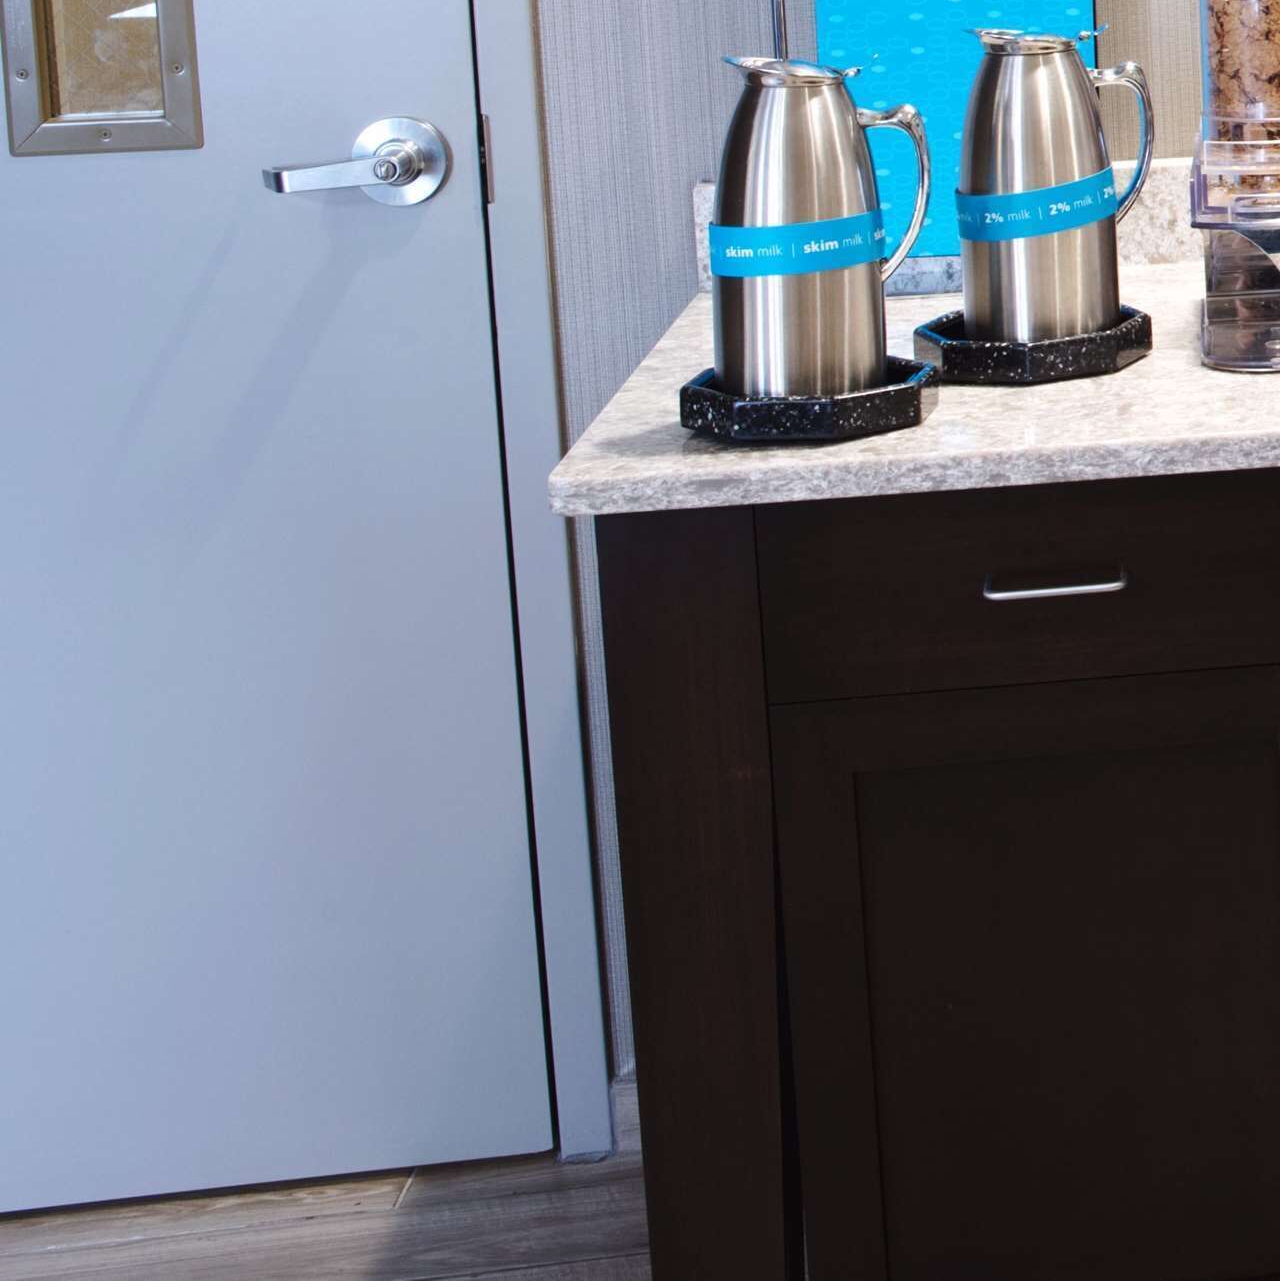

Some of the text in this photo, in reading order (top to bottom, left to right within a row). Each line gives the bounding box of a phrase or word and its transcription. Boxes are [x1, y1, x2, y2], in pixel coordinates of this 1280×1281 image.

[984, 212, 1005, 224] 2%
[1008, 209, 1032, 222] milk
[1049, 204, 1071, 216] 2%
[1073, 196, 1094, 209] milk
[725, 245, 754, 259] skim
[757, 244, 783, 258] milk
[803, 239, 840, 255] skim
[842, 234, 864, 248] milk
